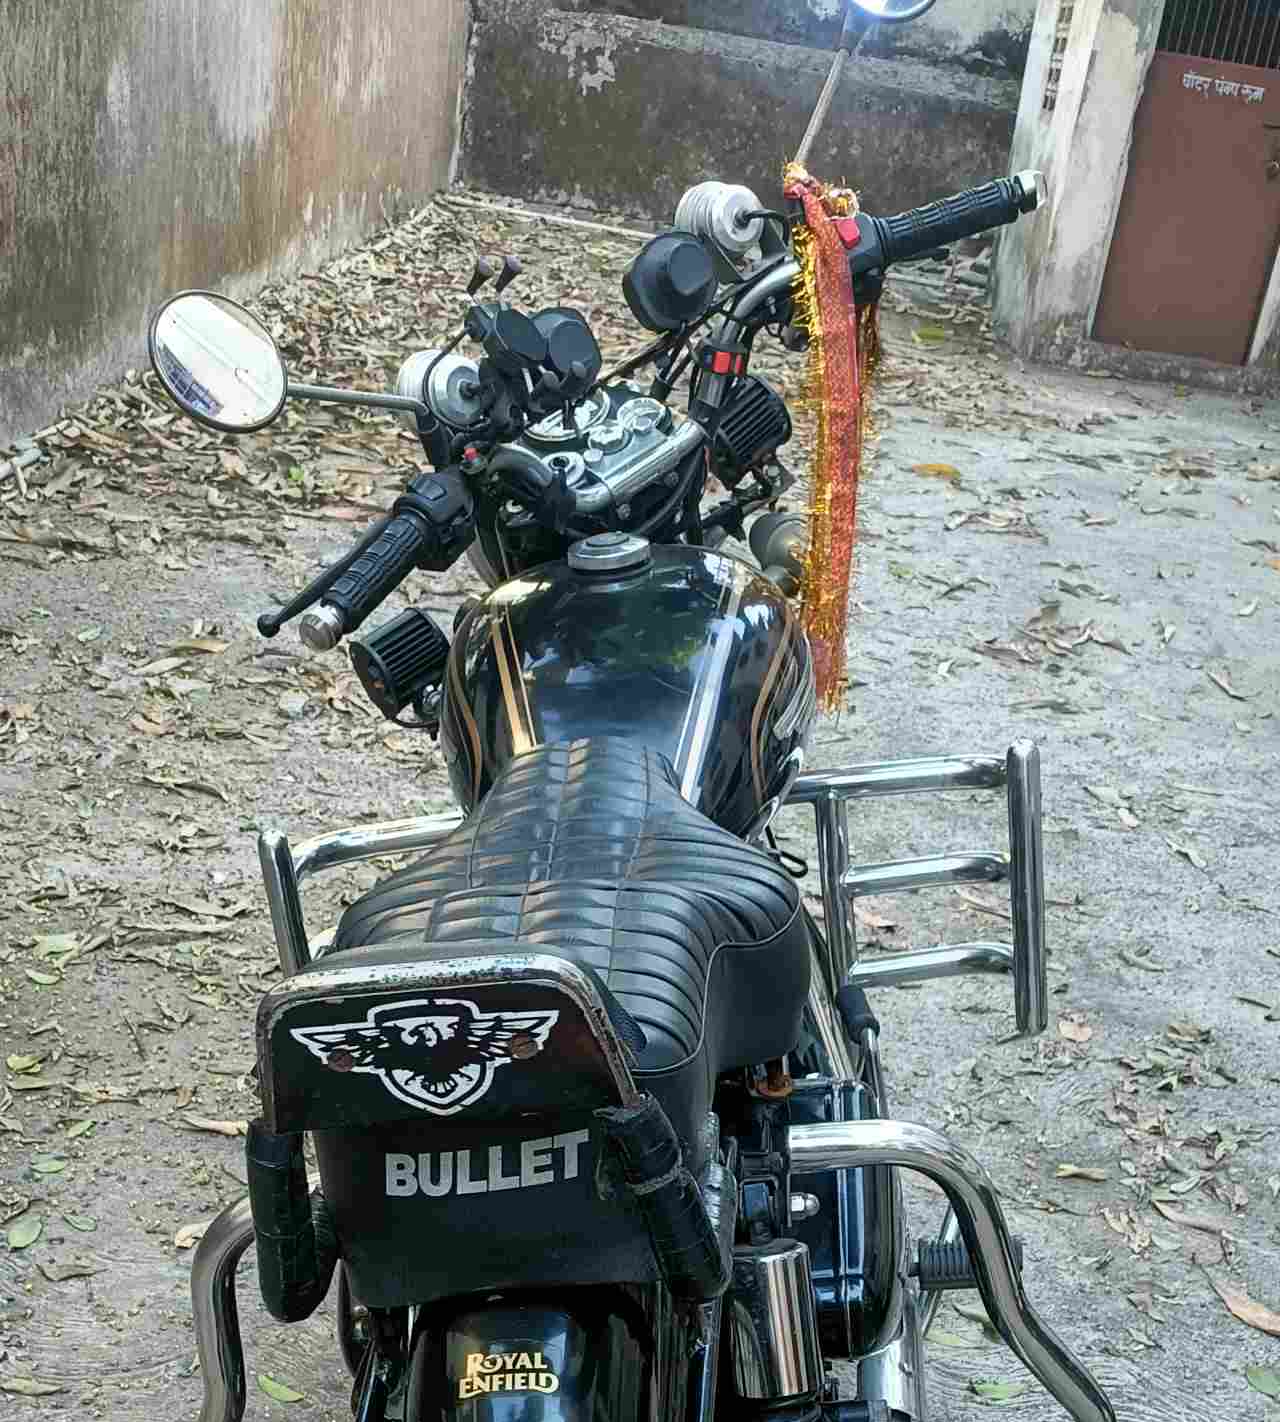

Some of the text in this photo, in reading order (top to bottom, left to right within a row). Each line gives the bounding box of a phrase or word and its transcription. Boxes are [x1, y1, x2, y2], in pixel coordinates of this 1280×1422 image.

[384, 1129, 590, 1198] BULLET
[466, 1352, 547, 1377] ROYAL
[458, 1372, 560, 1399] ENFIELD
